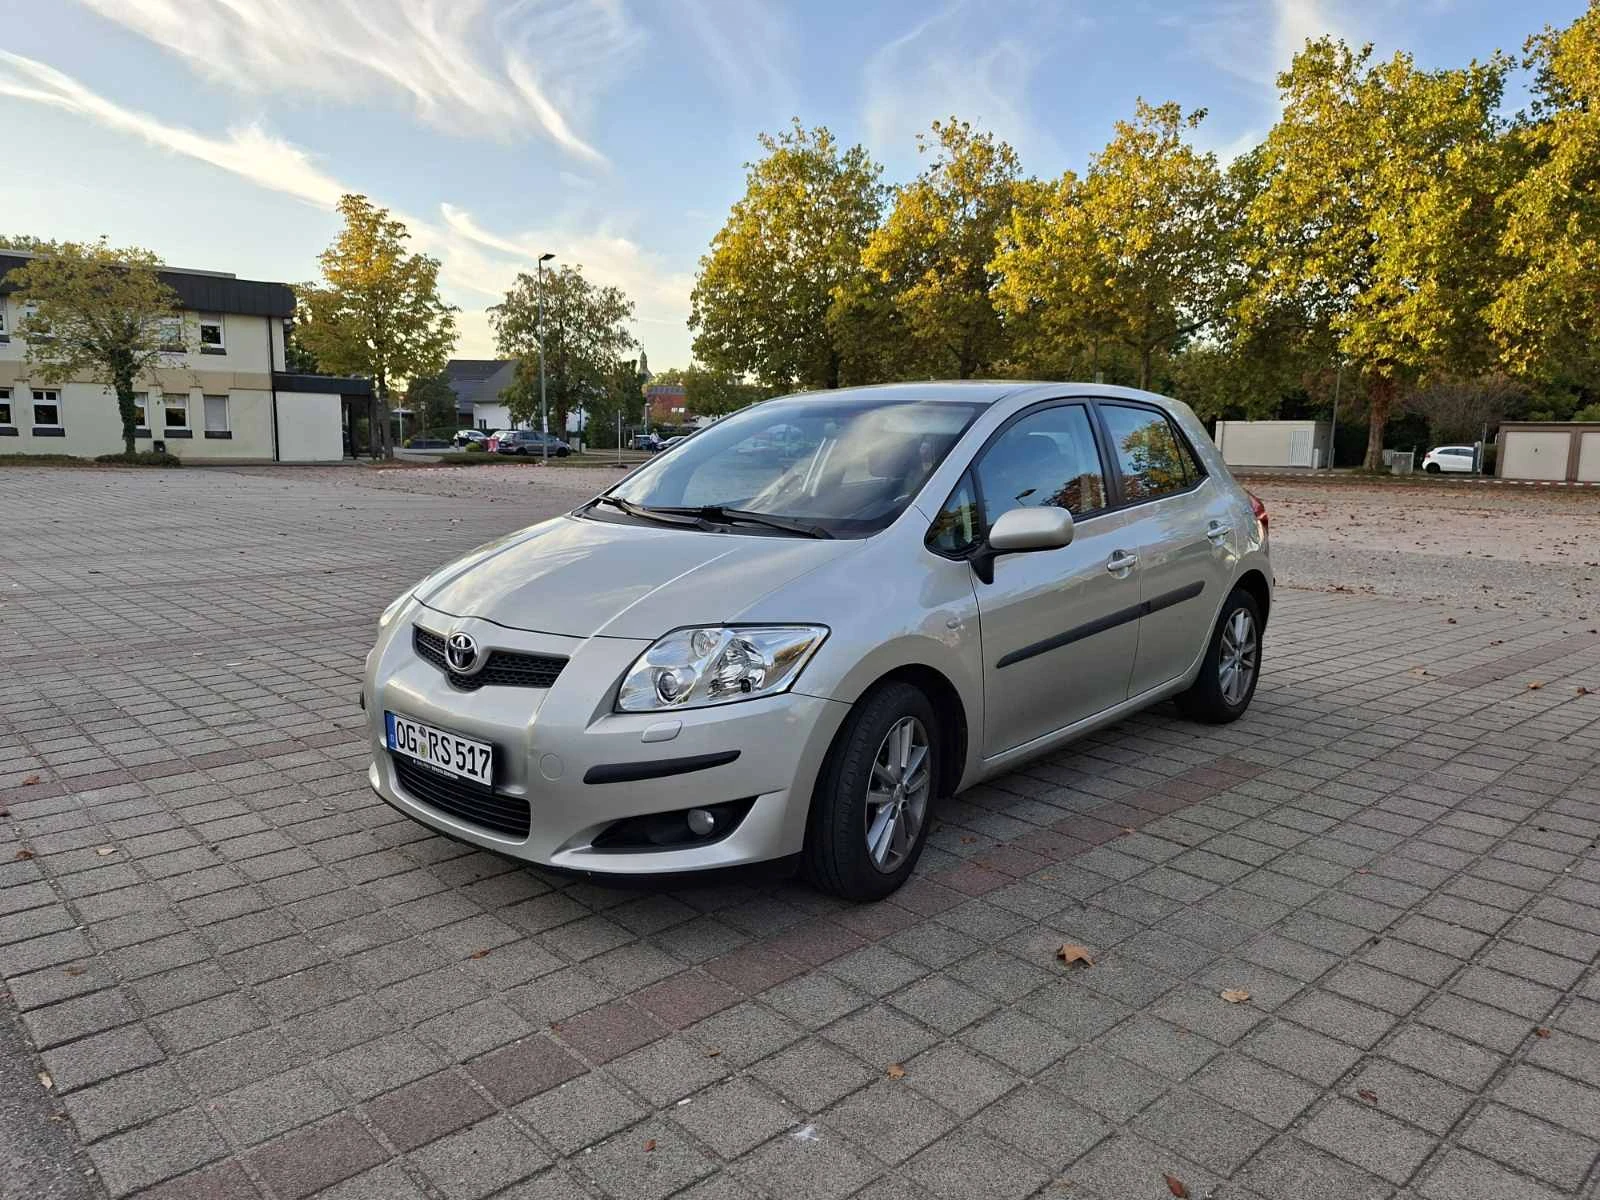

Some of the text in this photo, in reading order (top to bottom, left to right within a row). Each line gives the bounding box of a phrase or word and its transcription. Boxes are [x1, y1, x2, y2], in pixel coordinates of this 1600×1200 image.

[396, 721, 418, 753] OG
[428, 732, 451, 765] RS
[455, 741, 490, 778] 517
